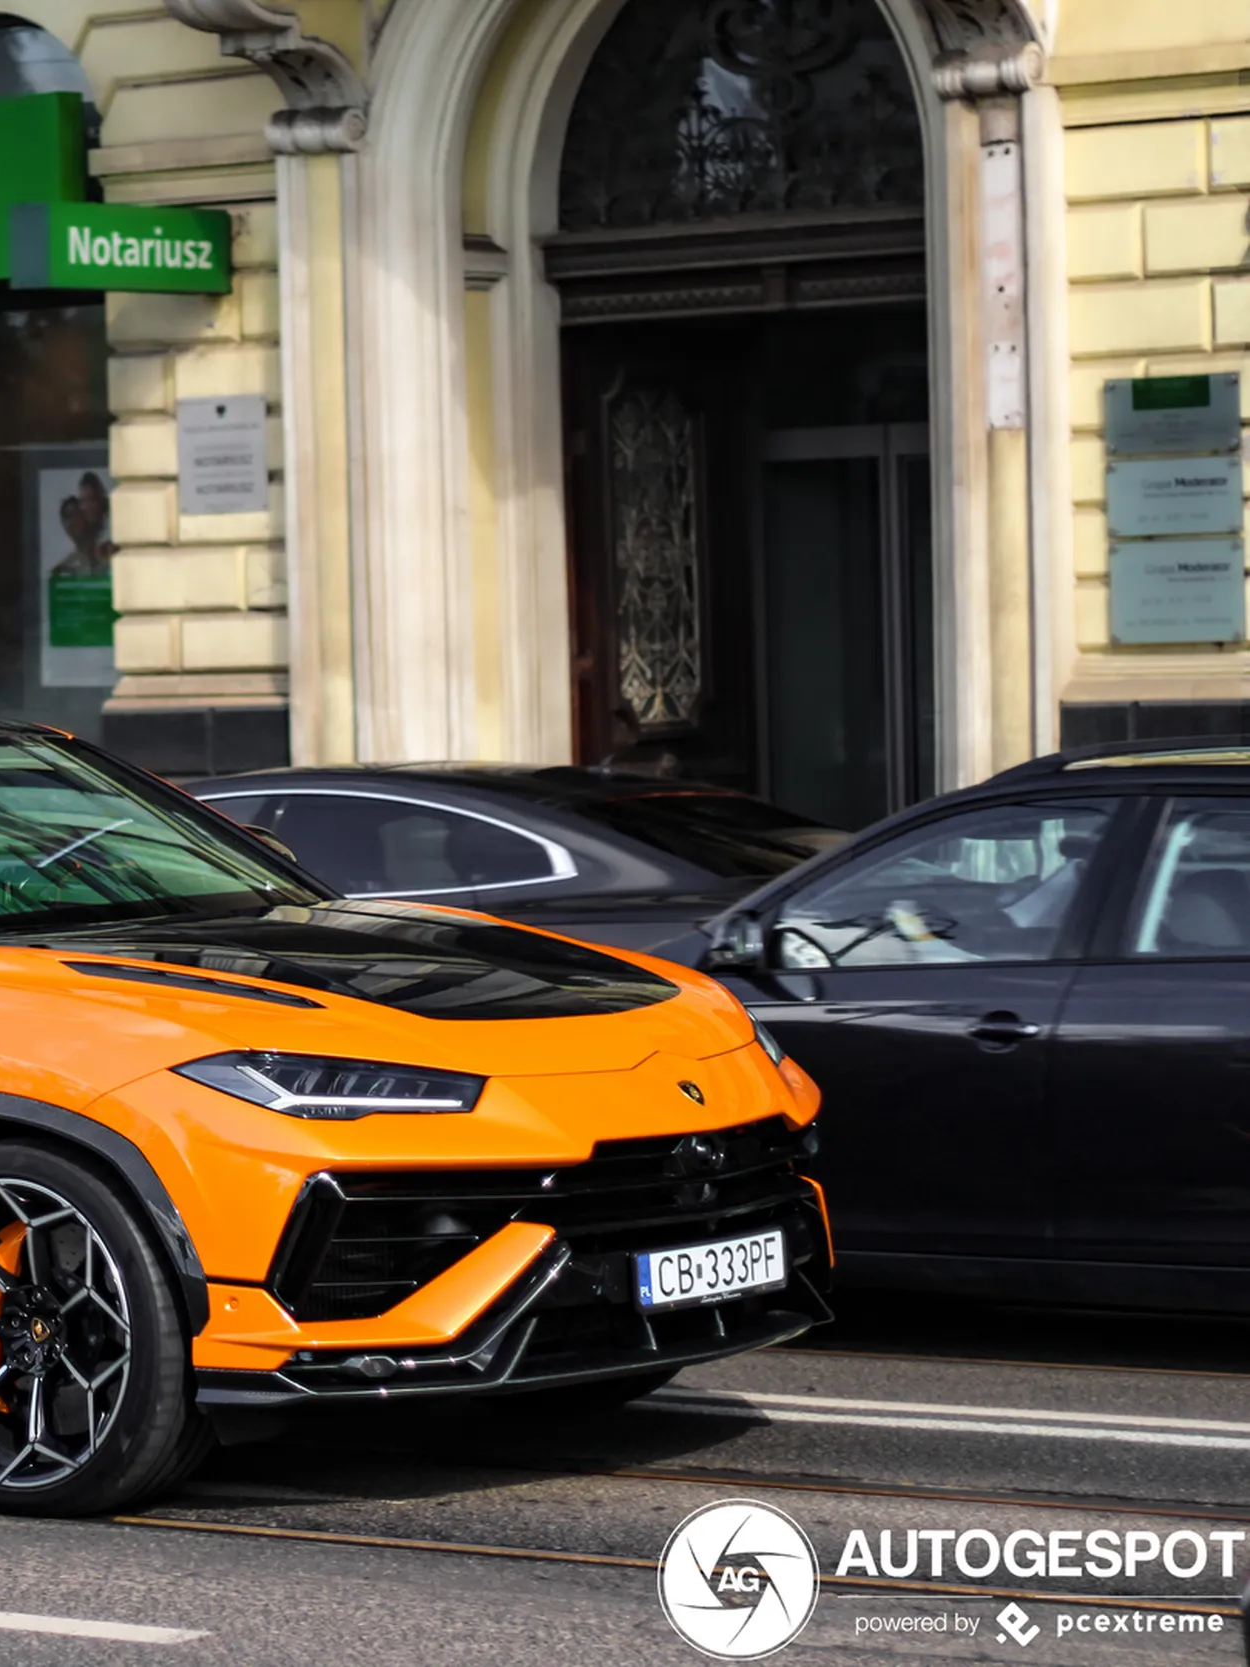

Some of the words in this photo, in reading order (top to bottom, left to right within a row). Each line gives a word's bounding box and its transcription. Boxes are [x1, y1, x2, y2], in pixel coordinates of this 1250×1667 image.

[68, 226, 213, 270] Notariusz
[658, 1253, 695, 1297] CB
[705, 1236, 776, 1289] 333PF
[640, 1286, 652, 1298] PL
